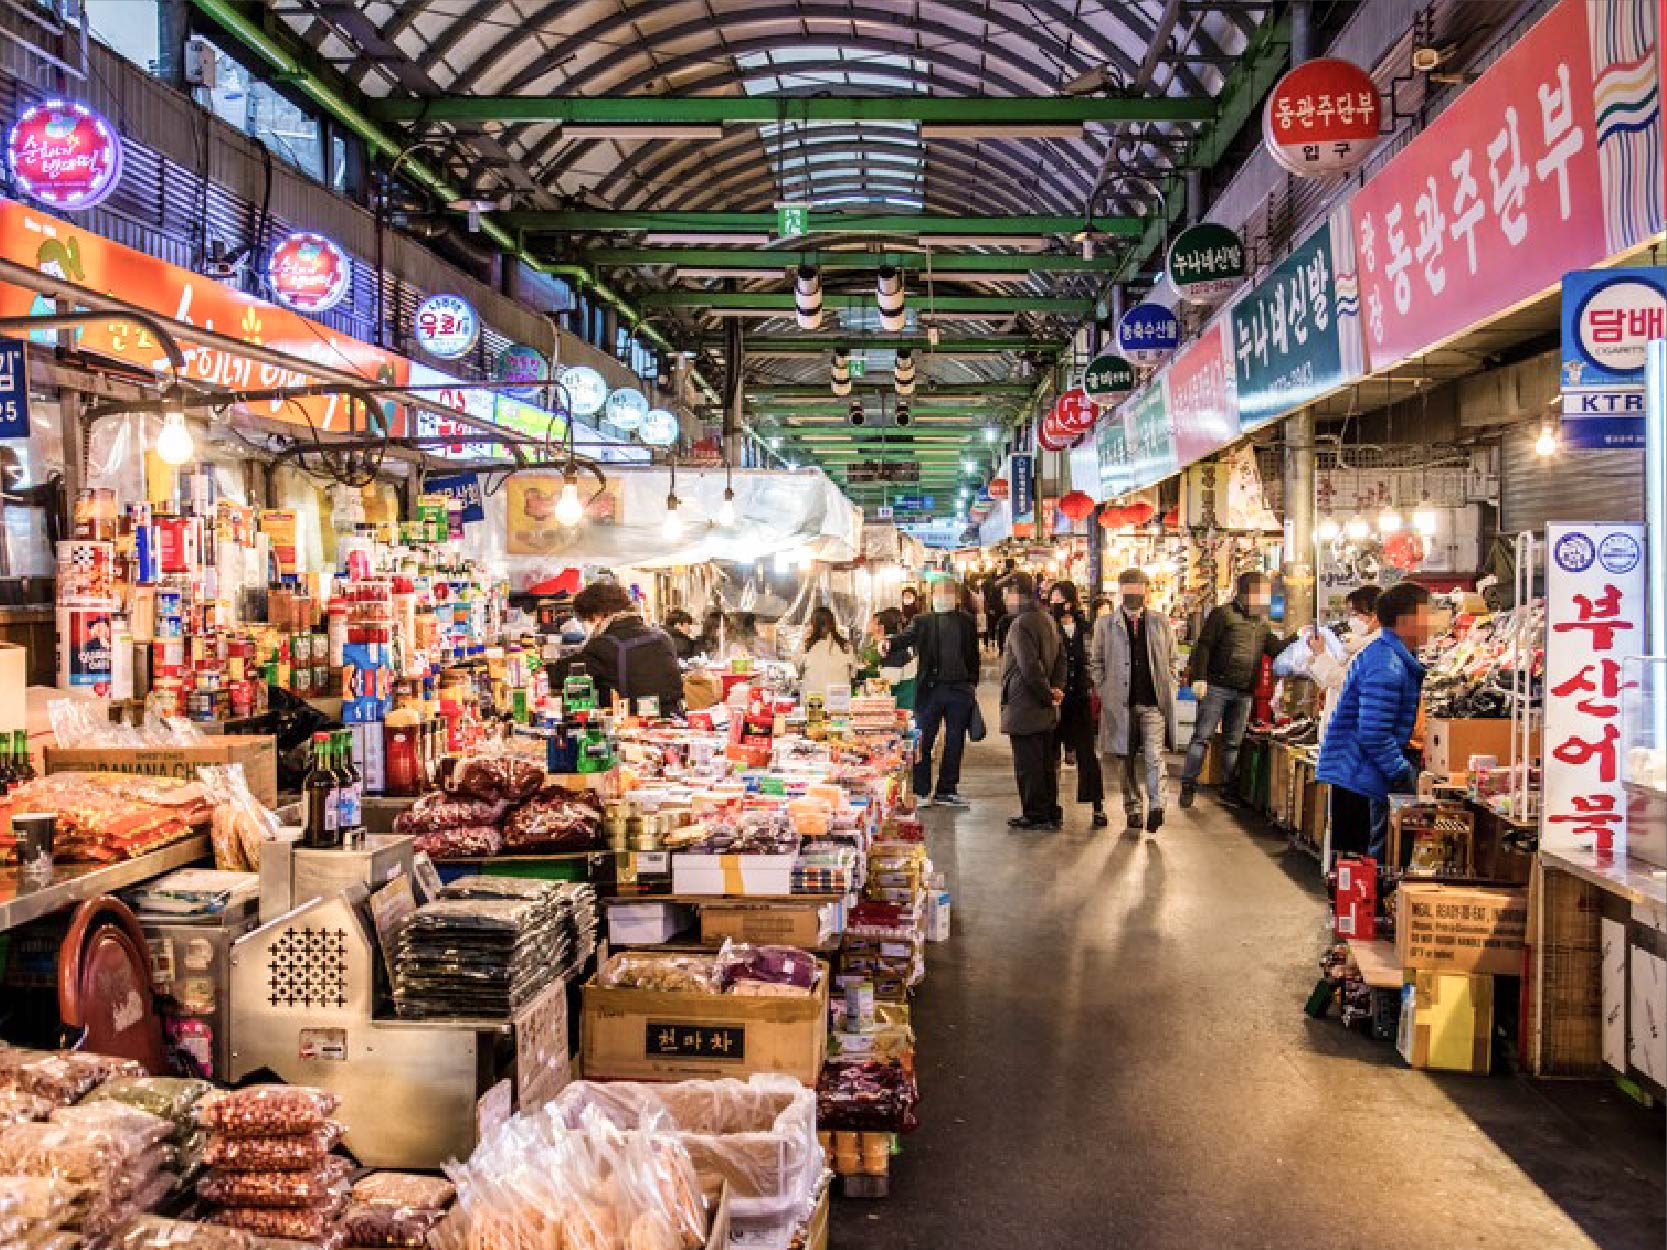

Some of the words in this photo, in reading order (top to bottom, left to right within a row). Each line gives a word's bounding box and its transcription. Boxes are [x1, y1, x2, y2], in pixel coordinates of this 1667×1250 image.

[1275, 93, 1375, 129] 동관주단부
[1303, 144, 1351, 162] 입구
[1384, 62, 1585, 315] 동관주단부
[1173, 244, 1241, 277] 누나네신발
[1236, 249, 1329, 380] 누나네신발
[1589, 308, 1665, 343] 담배
[1548, 583, 1639, 864] 부산어묵
[658, 1027, 733, 1053] 천마차
